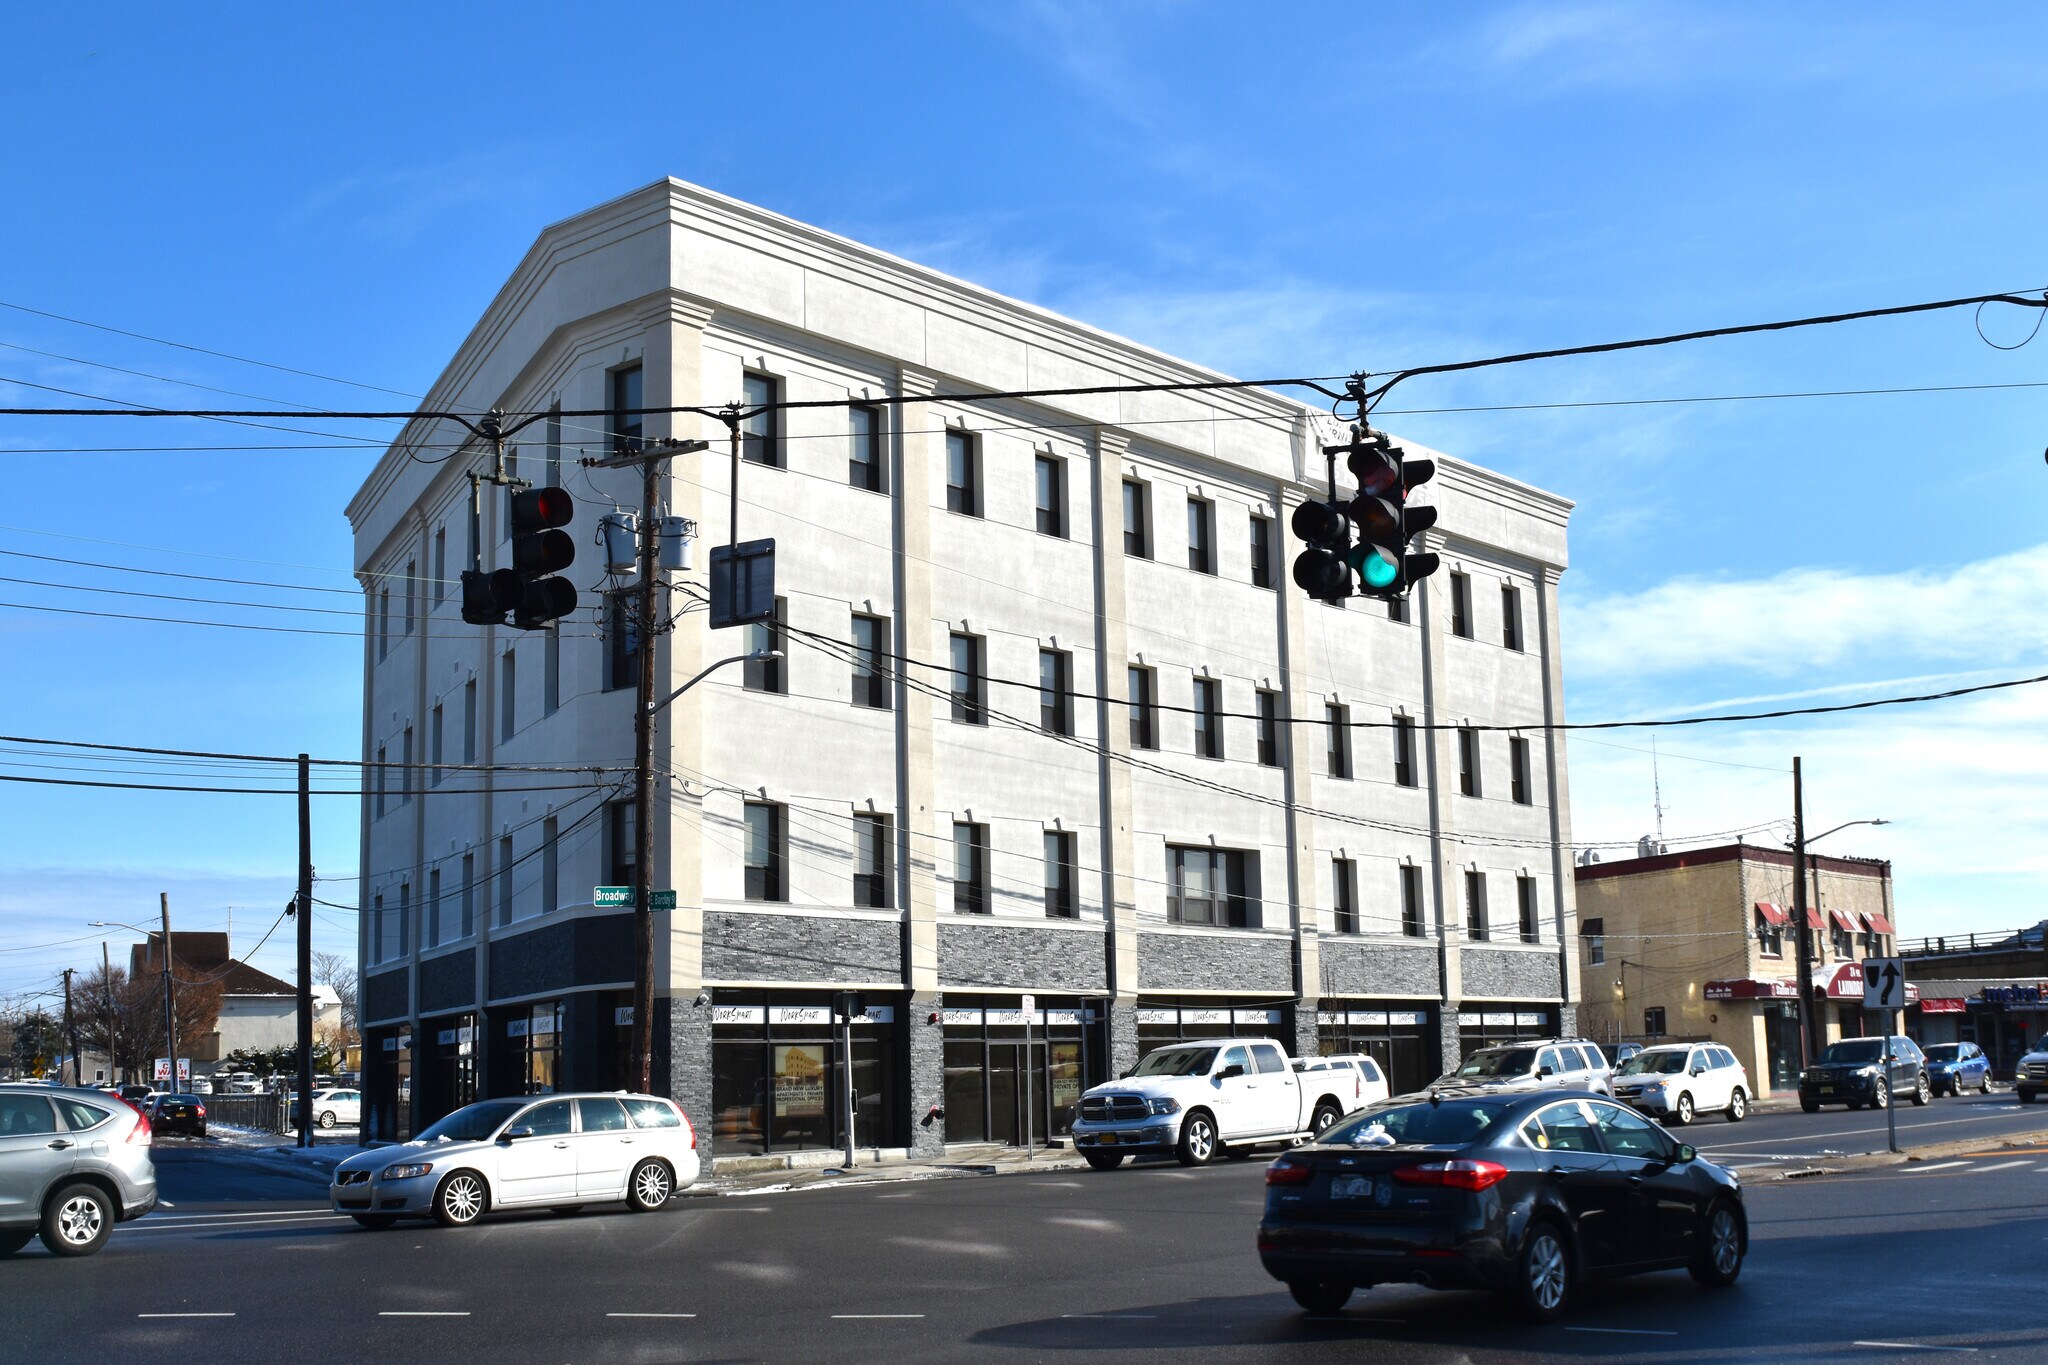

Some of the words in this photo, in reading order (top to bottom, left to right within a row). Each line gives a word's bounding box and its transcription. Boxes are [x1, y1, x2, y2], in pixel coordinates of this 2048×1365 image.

[596, 890, 635, 902] Broadway
[655, 894, 671, 906] Barclay
[1837, 979, 1865, 996] LAUNDRO
